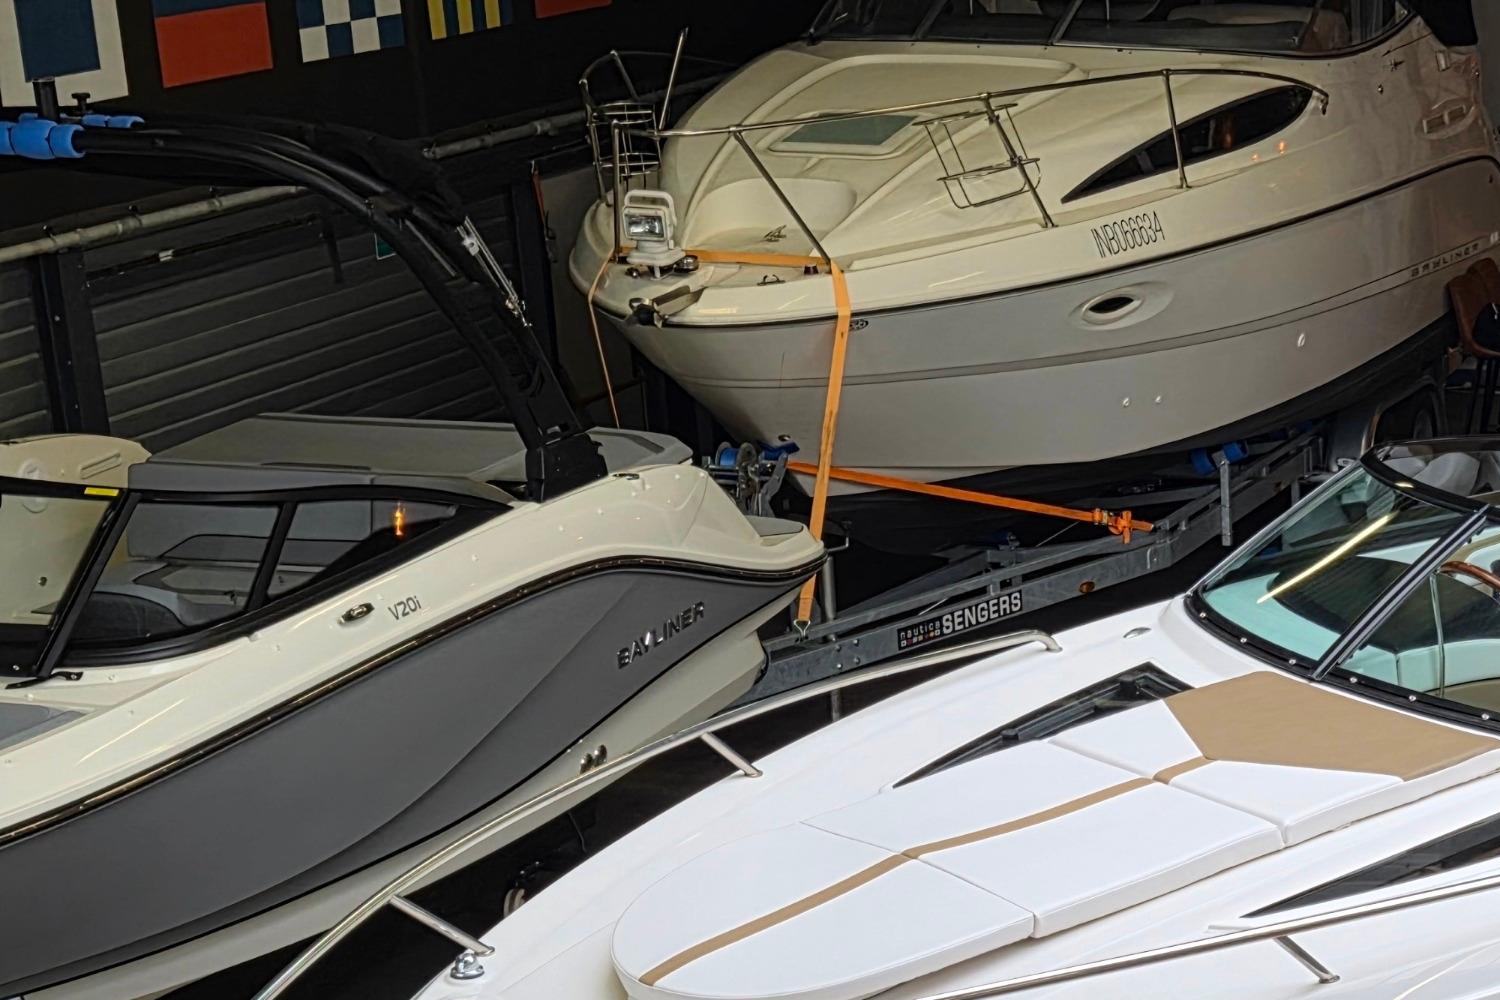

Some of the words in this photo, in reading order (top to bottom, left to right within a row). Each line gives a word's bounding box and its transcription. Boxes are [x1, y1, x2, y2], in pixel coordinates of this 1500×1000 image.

[1090, 210, 1166, 258] INB066634
[387, 595, 422, 620] V20i
[942, 591, 1021, 635] SENGERS
[616, 600, 705, 670] BAYLINER
